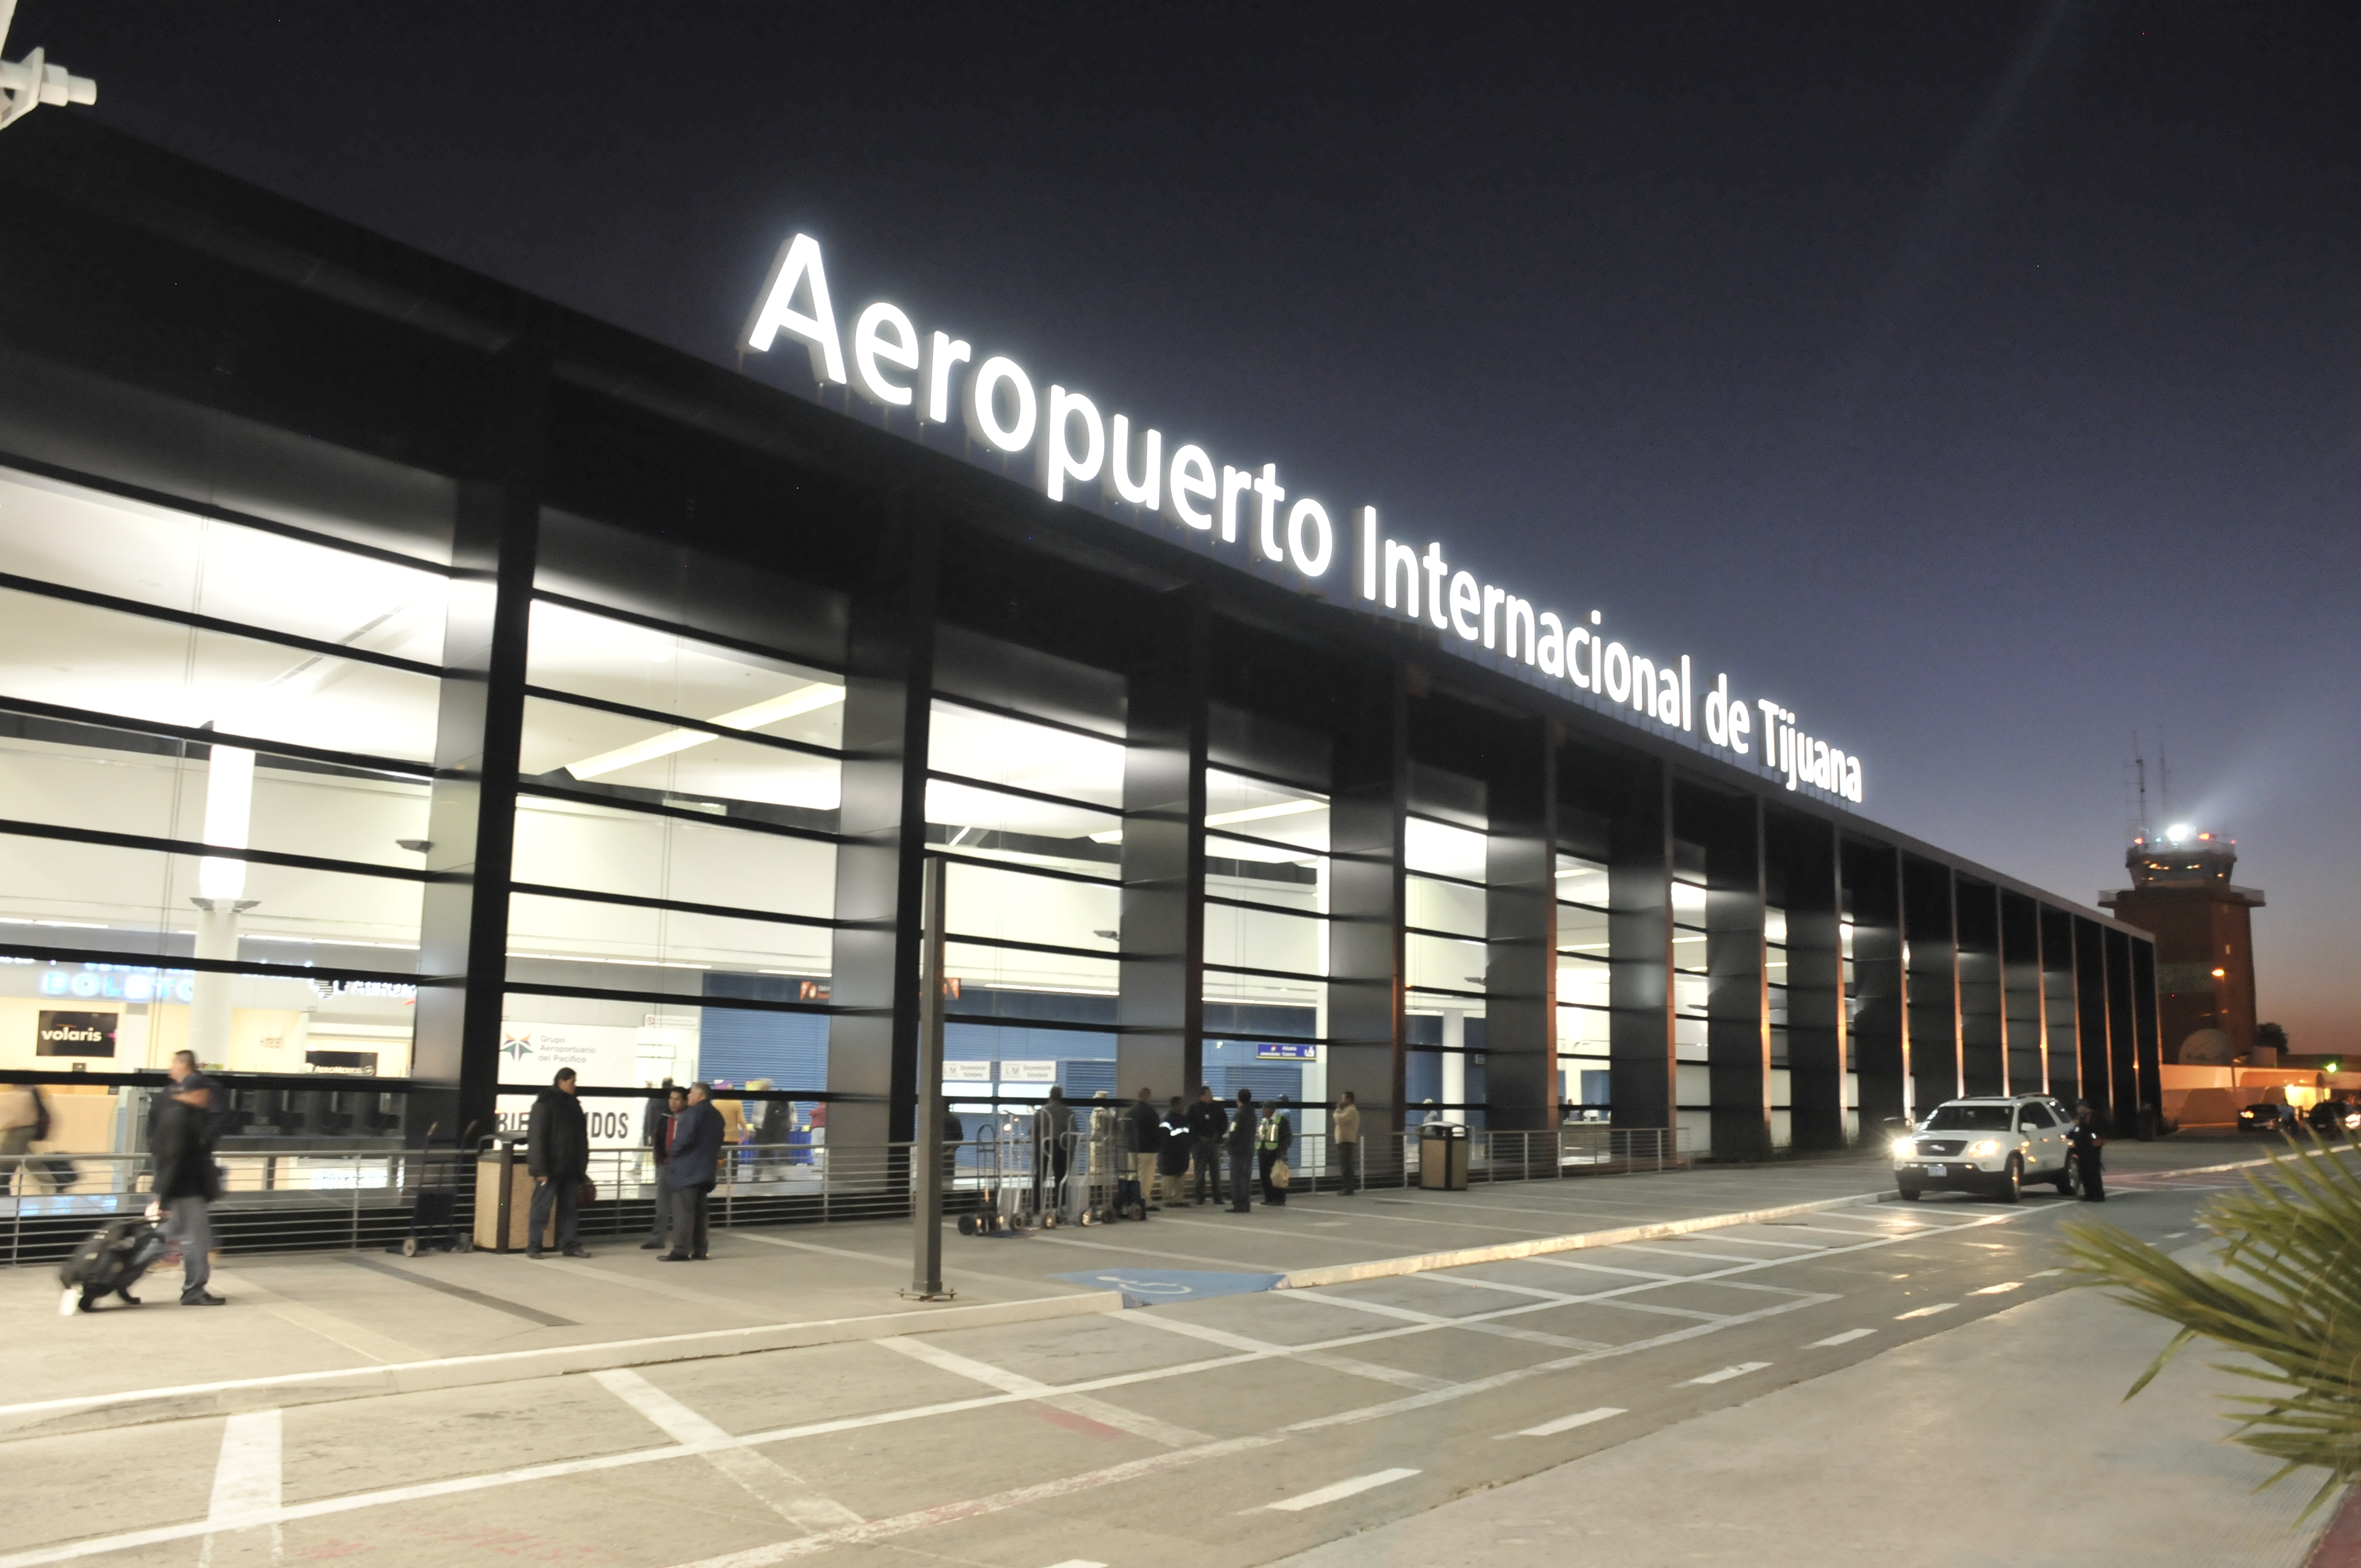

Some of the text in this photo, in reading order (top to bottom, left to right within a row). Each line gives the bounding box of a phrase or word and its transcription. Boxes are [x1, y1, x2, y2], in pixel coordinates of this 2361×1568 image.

[744, 232, 1862, 803] Aeropuerto Internacional de Tijuana
[41, 1027, 101, 1042] volaris
[540, 1045, 596, 1053] Aeroportuario
